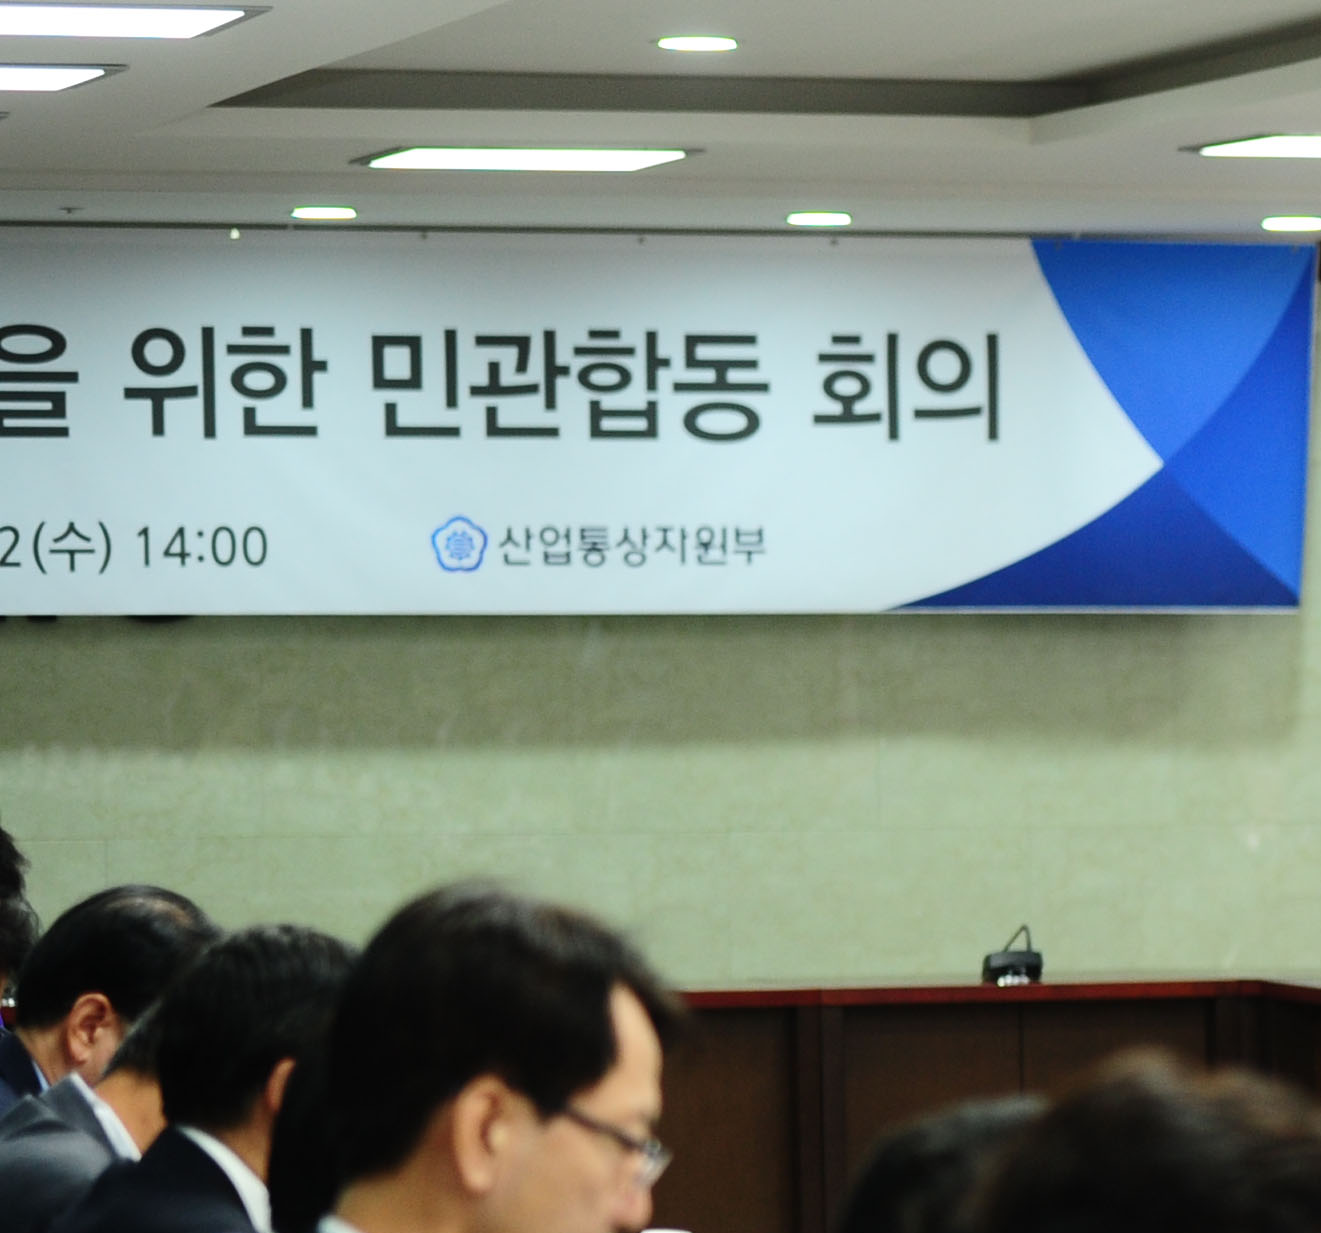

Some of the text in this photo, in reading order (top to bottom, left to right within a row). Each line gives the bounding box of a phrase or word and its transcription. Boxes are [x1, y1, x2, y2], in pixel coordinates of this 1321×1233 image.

[124, 325, 328, 440] 위한
[371, 328, 770, 442] 민관합동
[813, 332, 1000, 443] 회의
[0, 521, 268, 575] 2(수) 14:00
[499, 526, 765, 567] 산업통상자원부
